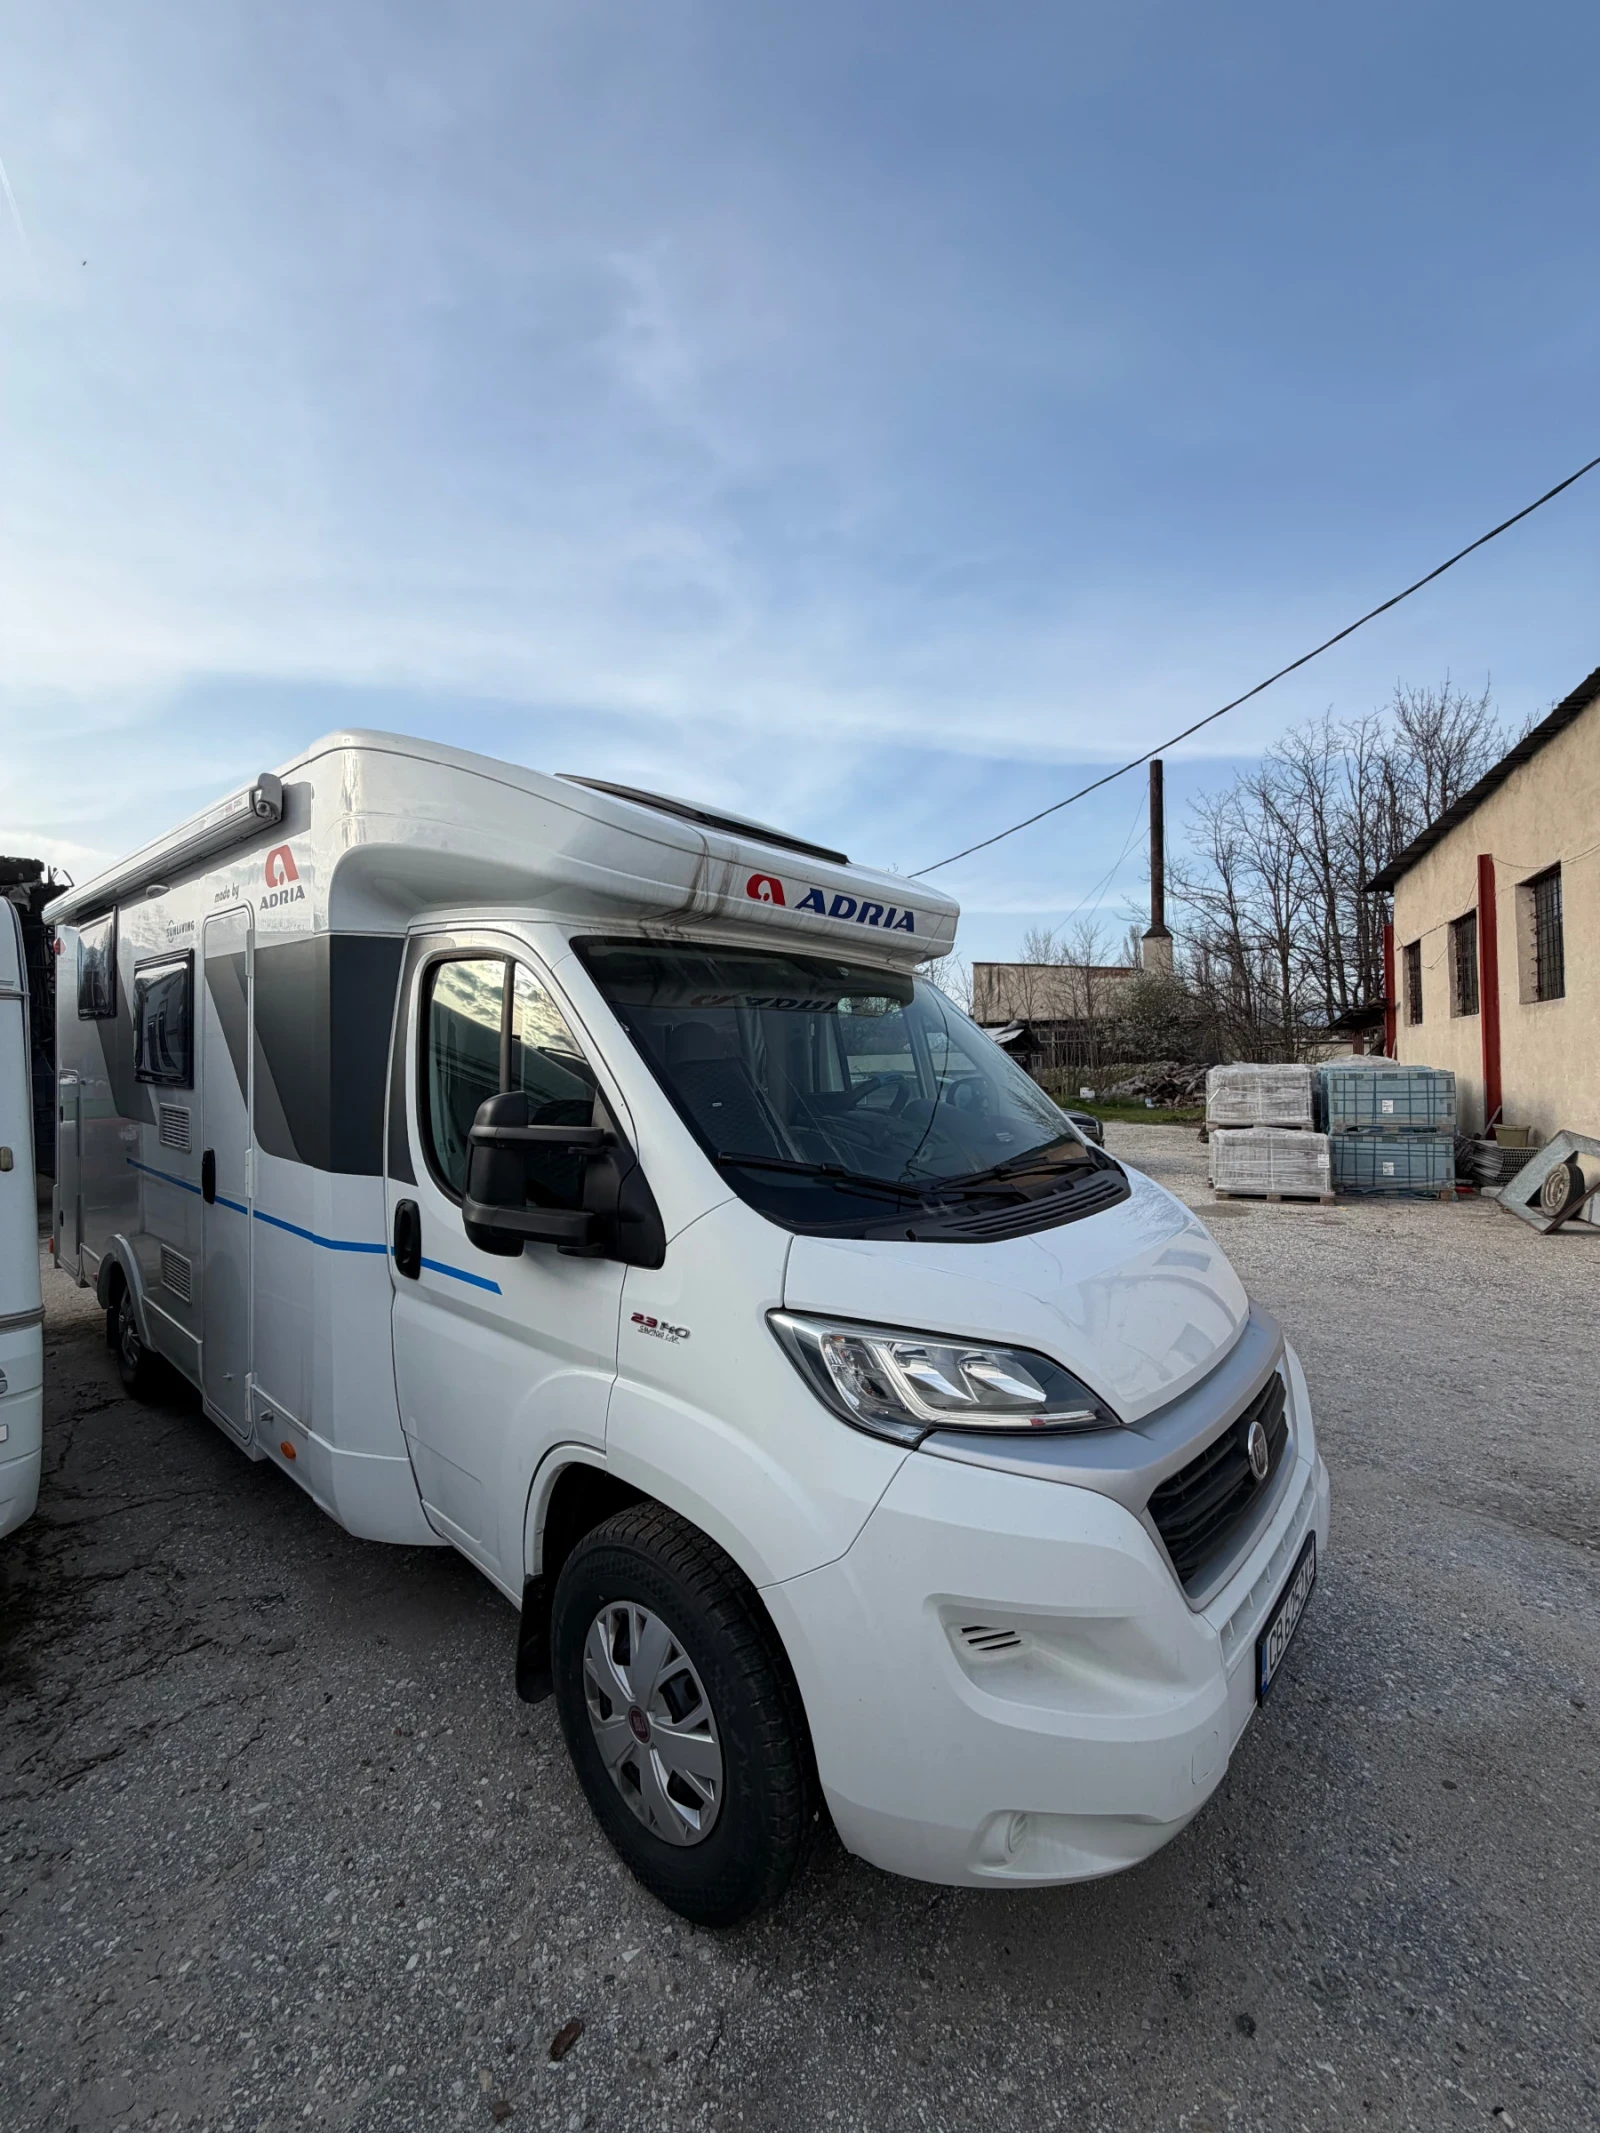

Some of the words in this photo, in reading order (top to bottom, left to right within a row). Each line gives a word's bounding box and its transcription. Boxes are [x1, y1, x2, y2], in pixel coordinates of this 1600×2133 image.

[232, 882, 240, 900] by
[259, 885, 305, 911] ADRIA
[794, 887, 915, 933] ADRIA
